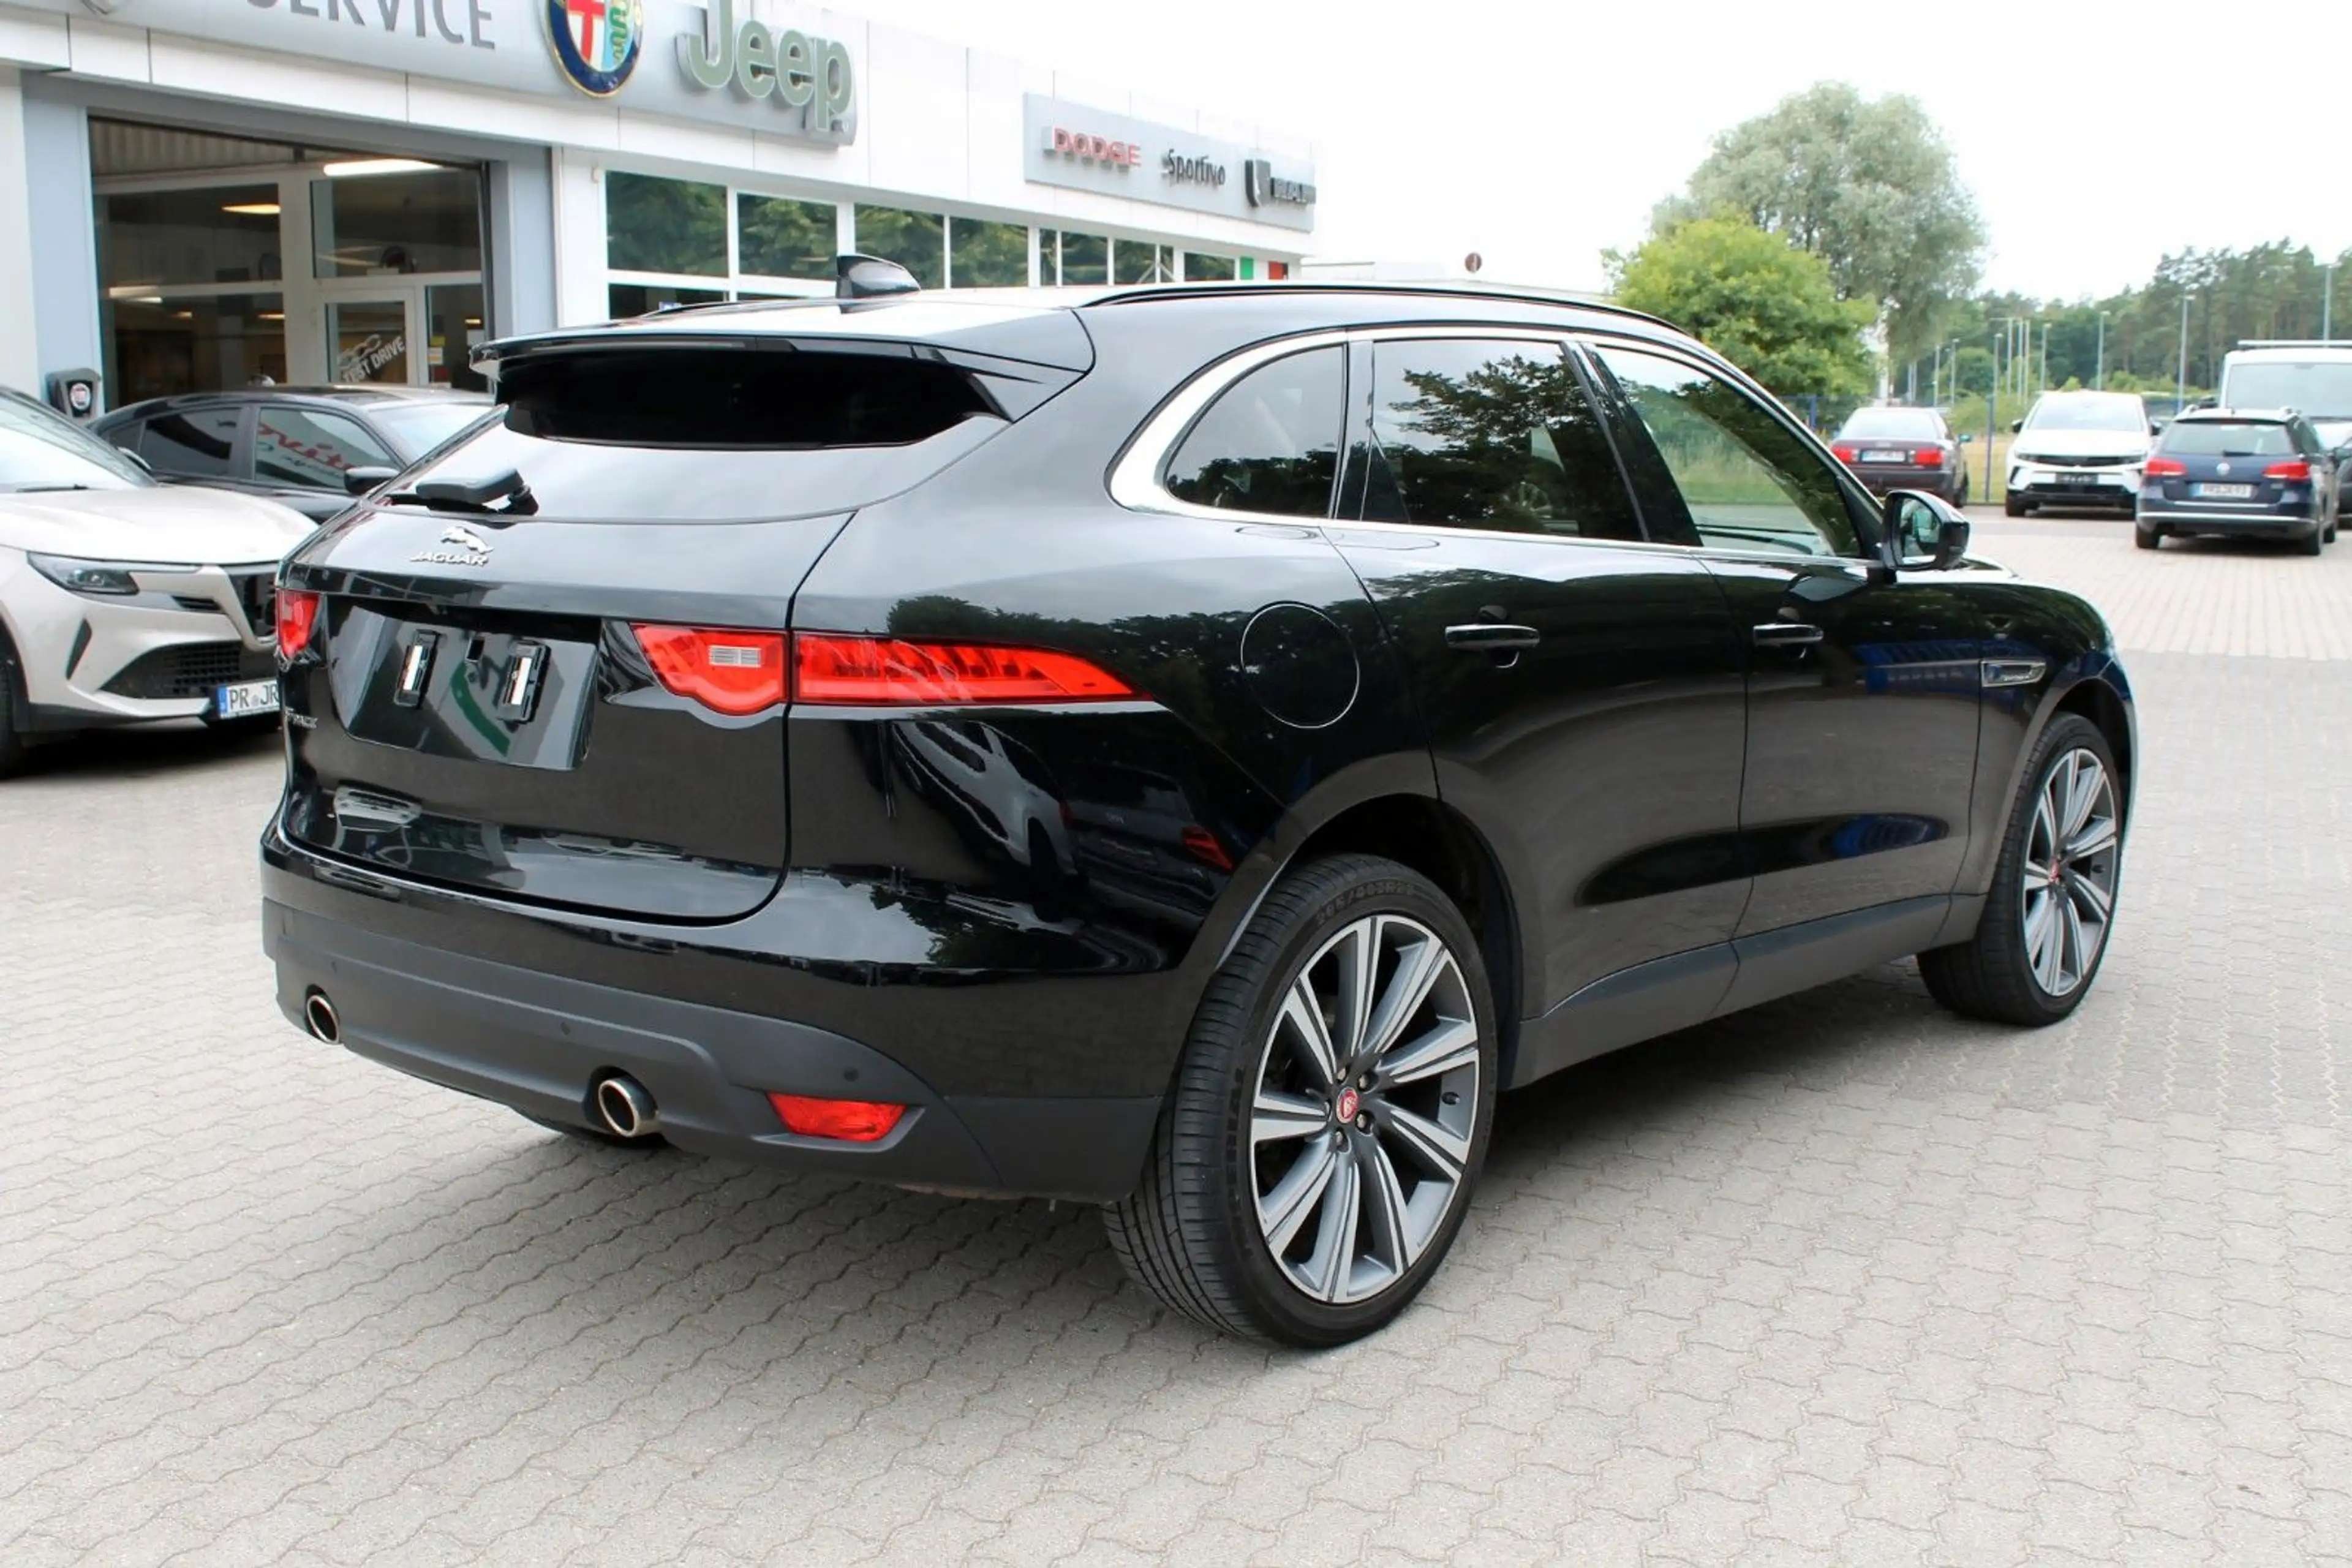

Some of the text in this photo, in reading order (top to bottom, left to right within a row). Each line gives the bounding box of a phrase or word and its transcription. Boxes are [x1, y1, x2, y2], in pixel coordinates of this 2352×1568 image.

[685, 0, 853, 131] Jeep
[1052, 126, 1142, 167] DODGE
[1166, 148, 1226, 186] Sportivo
[369, 336, 405, 369] DRIVE
[410, 551, 489, 567] JAGUAR
[229, 688, 249, 709] PR
